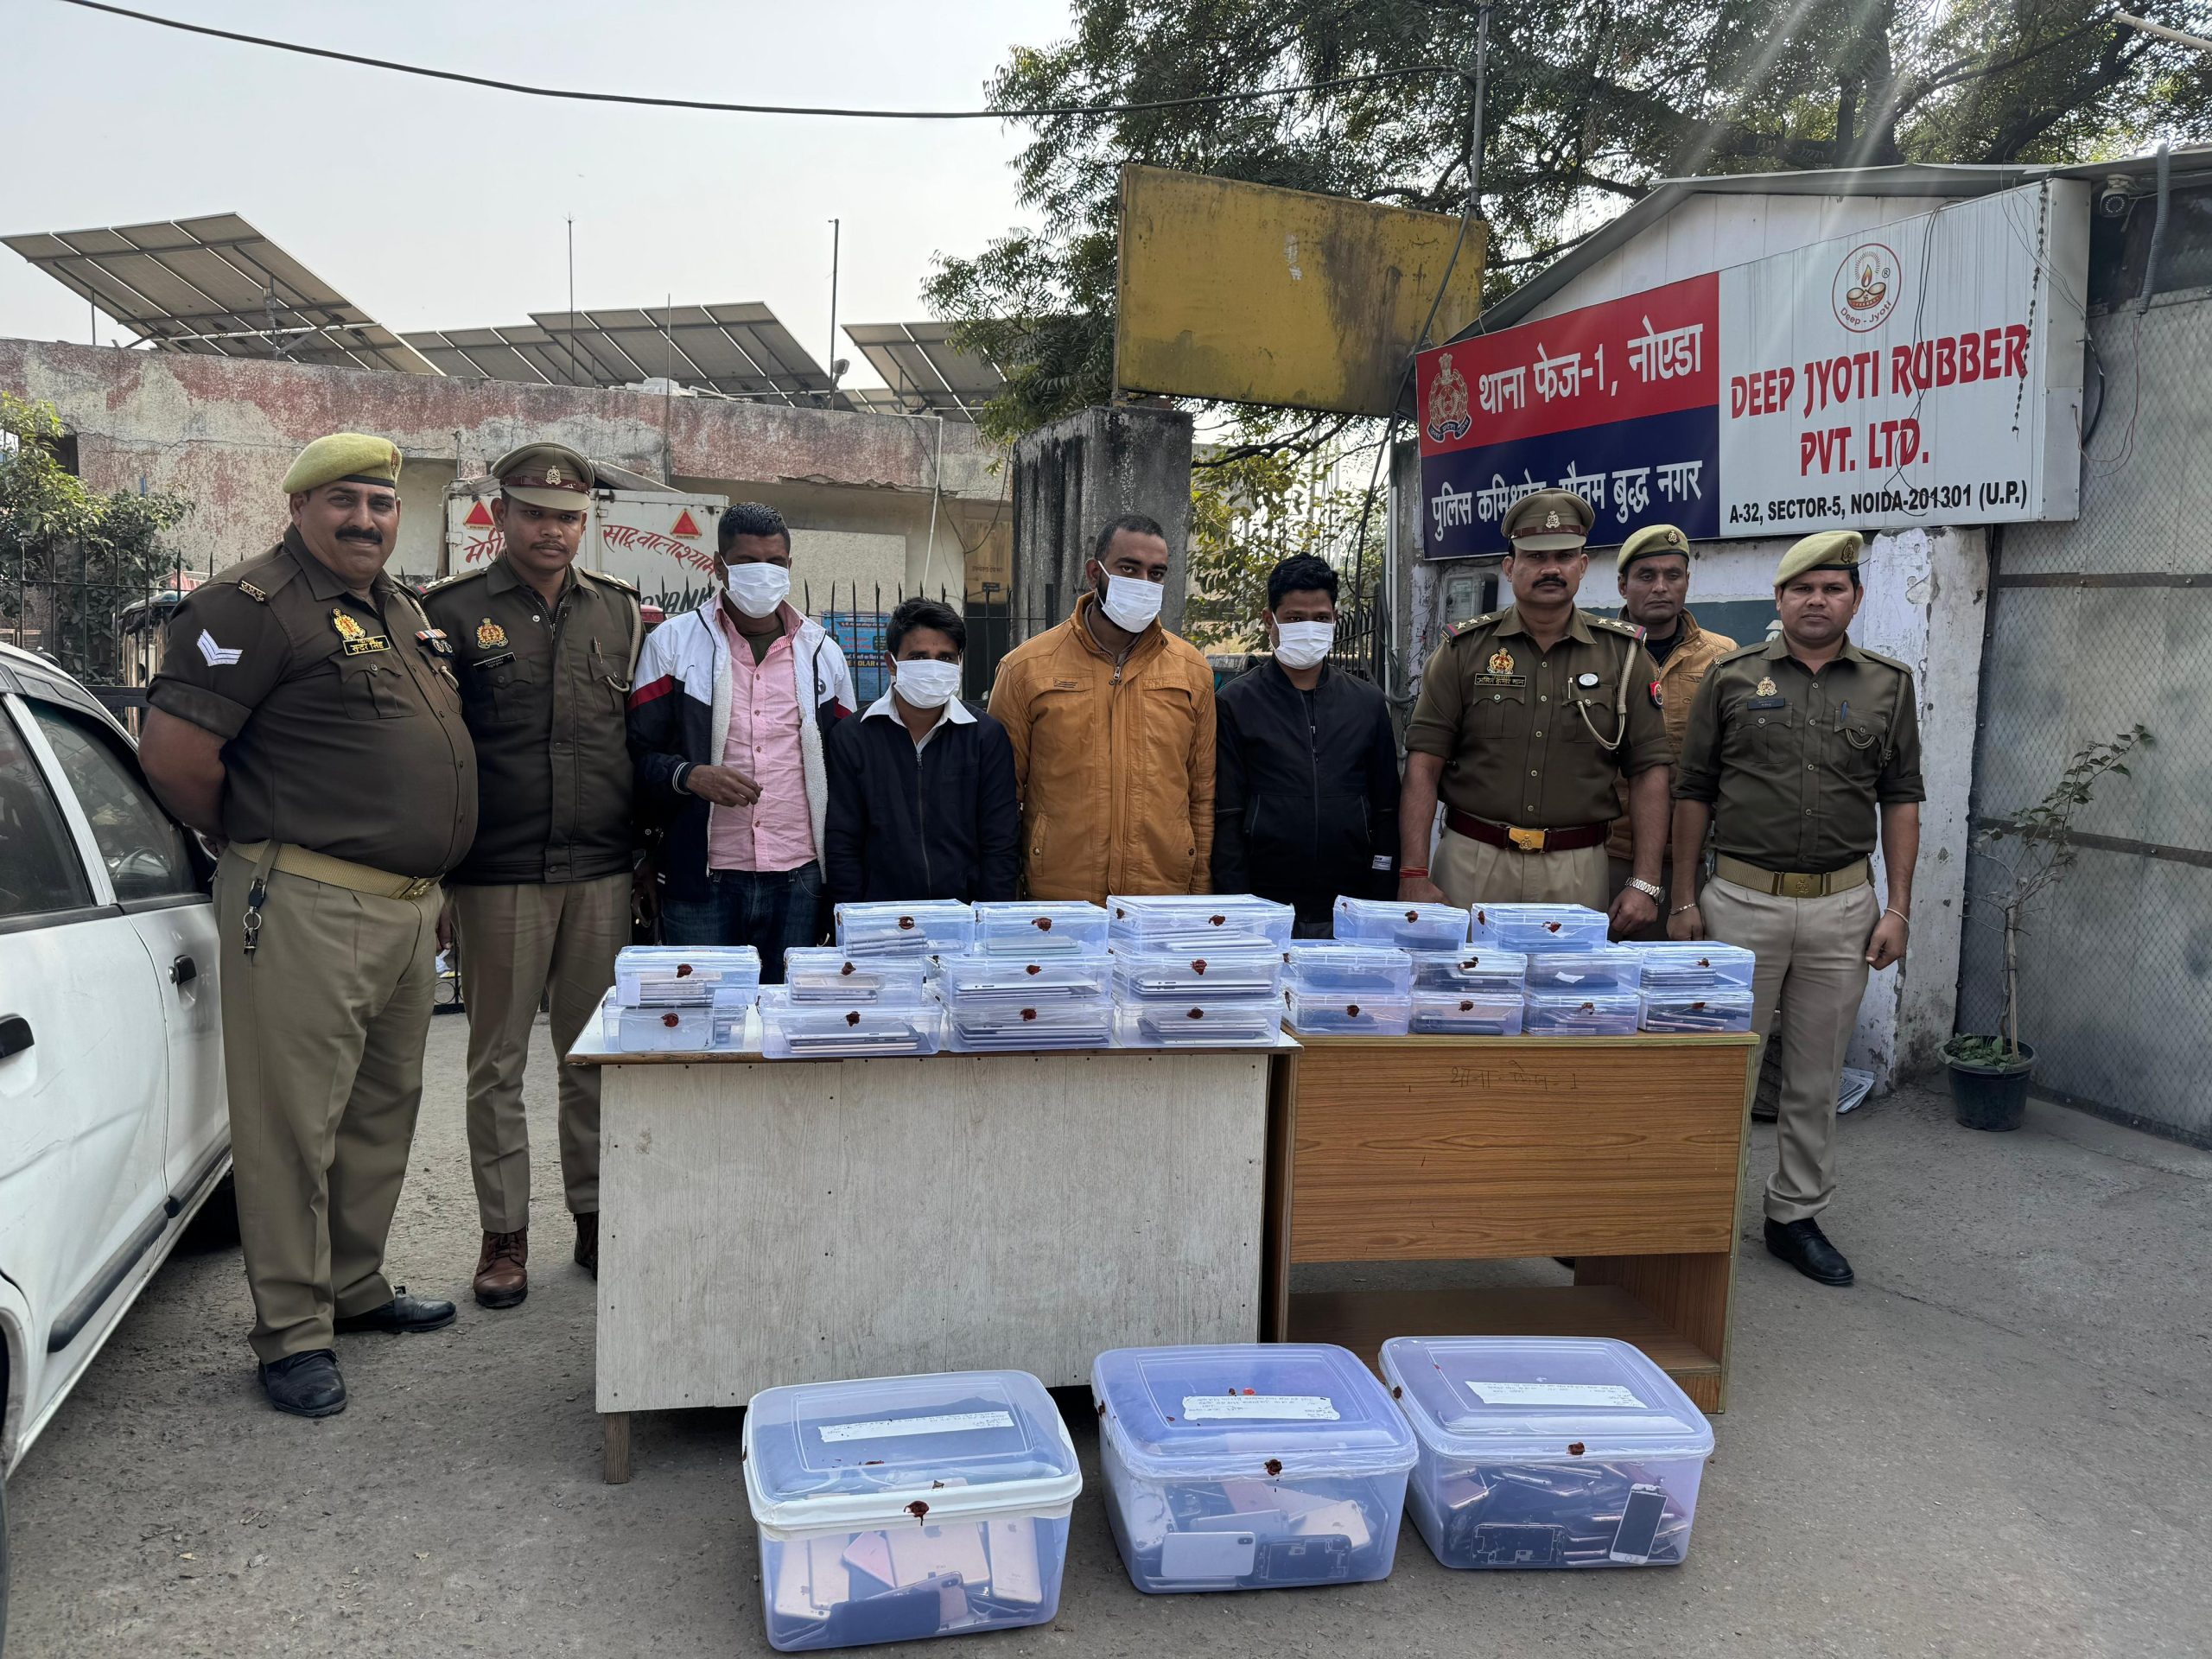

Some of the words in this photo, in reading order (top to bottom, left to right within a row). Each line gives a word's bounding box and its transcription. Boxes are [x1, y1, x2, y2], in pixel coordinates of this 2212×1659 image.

[1840, 307, 1861, 327] Deep
[1869, 301, 1892, 323] Jyoti
[1478, 370, 1526, 415] थाना
[1533, 341, 1618, 404] फेज-1,
[1626, 314, 1704, 384] नोएडा
[1730, 365, 1796, 420] DEEP
[1802, 350, 1880, 420] JYOTI
[1891, 323, 2029, 398] RUBBER
[1800, 426, 1857, 477] PVT.
[1867, 417, 1930, 470] LTD.
[1431, 480, 1472, 543] पुलिस
[1612, 467, 1651, 524] बुद्ध
[1656, 460, 1703, 503] नगर
[1729, 502, 1764, 525] A-32,
[1767, 494, 1846, 523] SECTOR-5,
[1851, 483, 1971, 515] NOIDA-201301
[1979, 480, 2028, 513] (U.P.)
